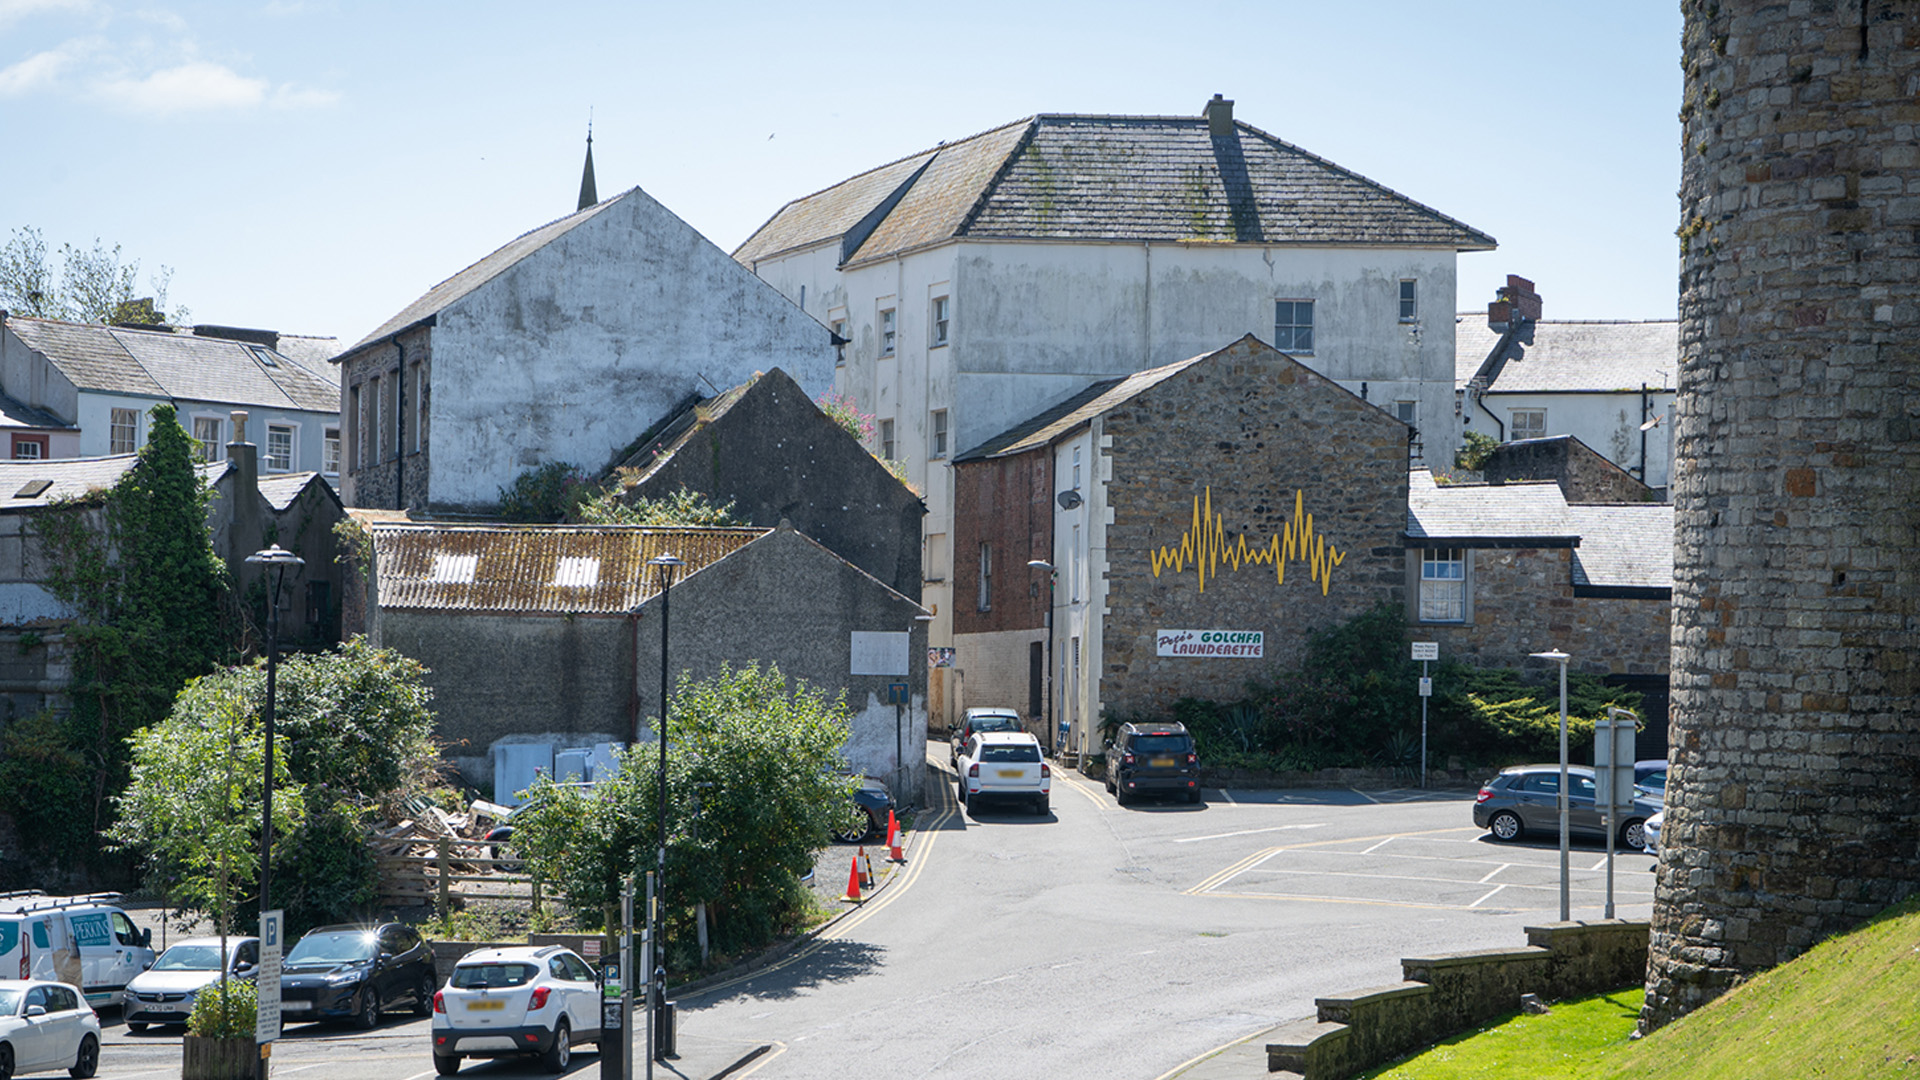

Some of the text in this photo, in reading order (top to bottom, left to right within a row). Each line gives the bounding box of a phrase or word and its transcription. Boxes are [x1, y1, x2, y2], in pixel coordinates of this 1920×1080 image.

[1158, 631, 1261, 648] Pete's GOLCHFA
[1172, 644, 1261, 655] LAUNDERETTE
[74, 920, 109, 940] PERKINS
[268, 921, 276, 943] P
[608, 967, 616, 977] P
